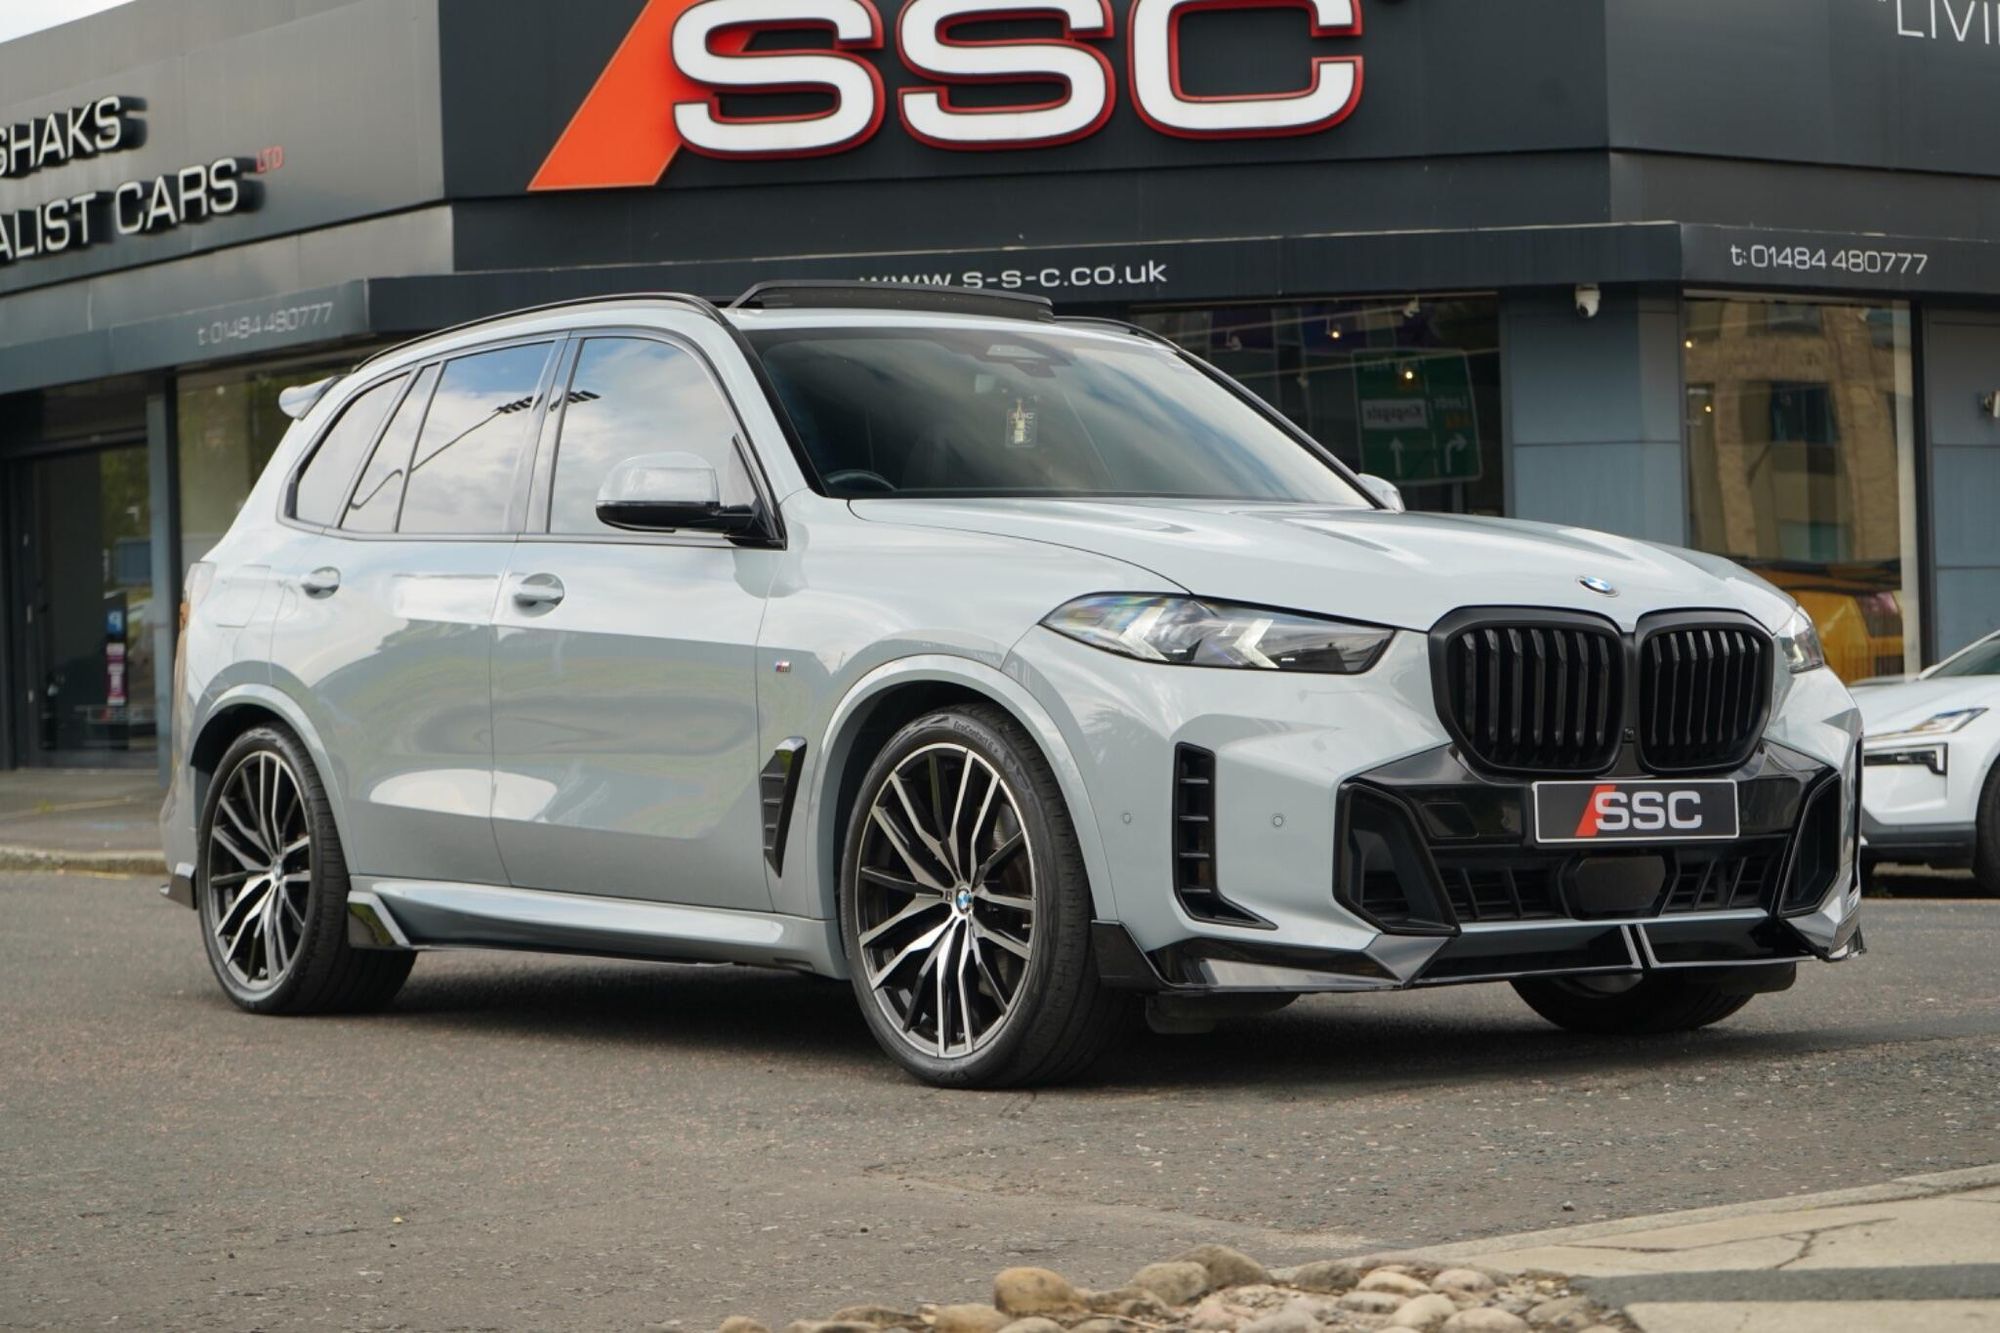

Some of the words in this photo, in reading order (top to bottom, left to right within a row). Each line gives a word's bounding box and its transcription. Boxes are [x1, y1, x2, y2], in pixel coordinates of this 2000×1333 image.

[1896, 0, 2000, 45] LIVI
[671, 0, 1363, 160] SSC
[114, 157, 239, 235] CARS
[256, 146, 284, 172] LTD
[1731, 244, 1827, 270] t:01484
[1831, 250, 1928, 275] 480777
[1595, 791, 1702, 831] SSC
